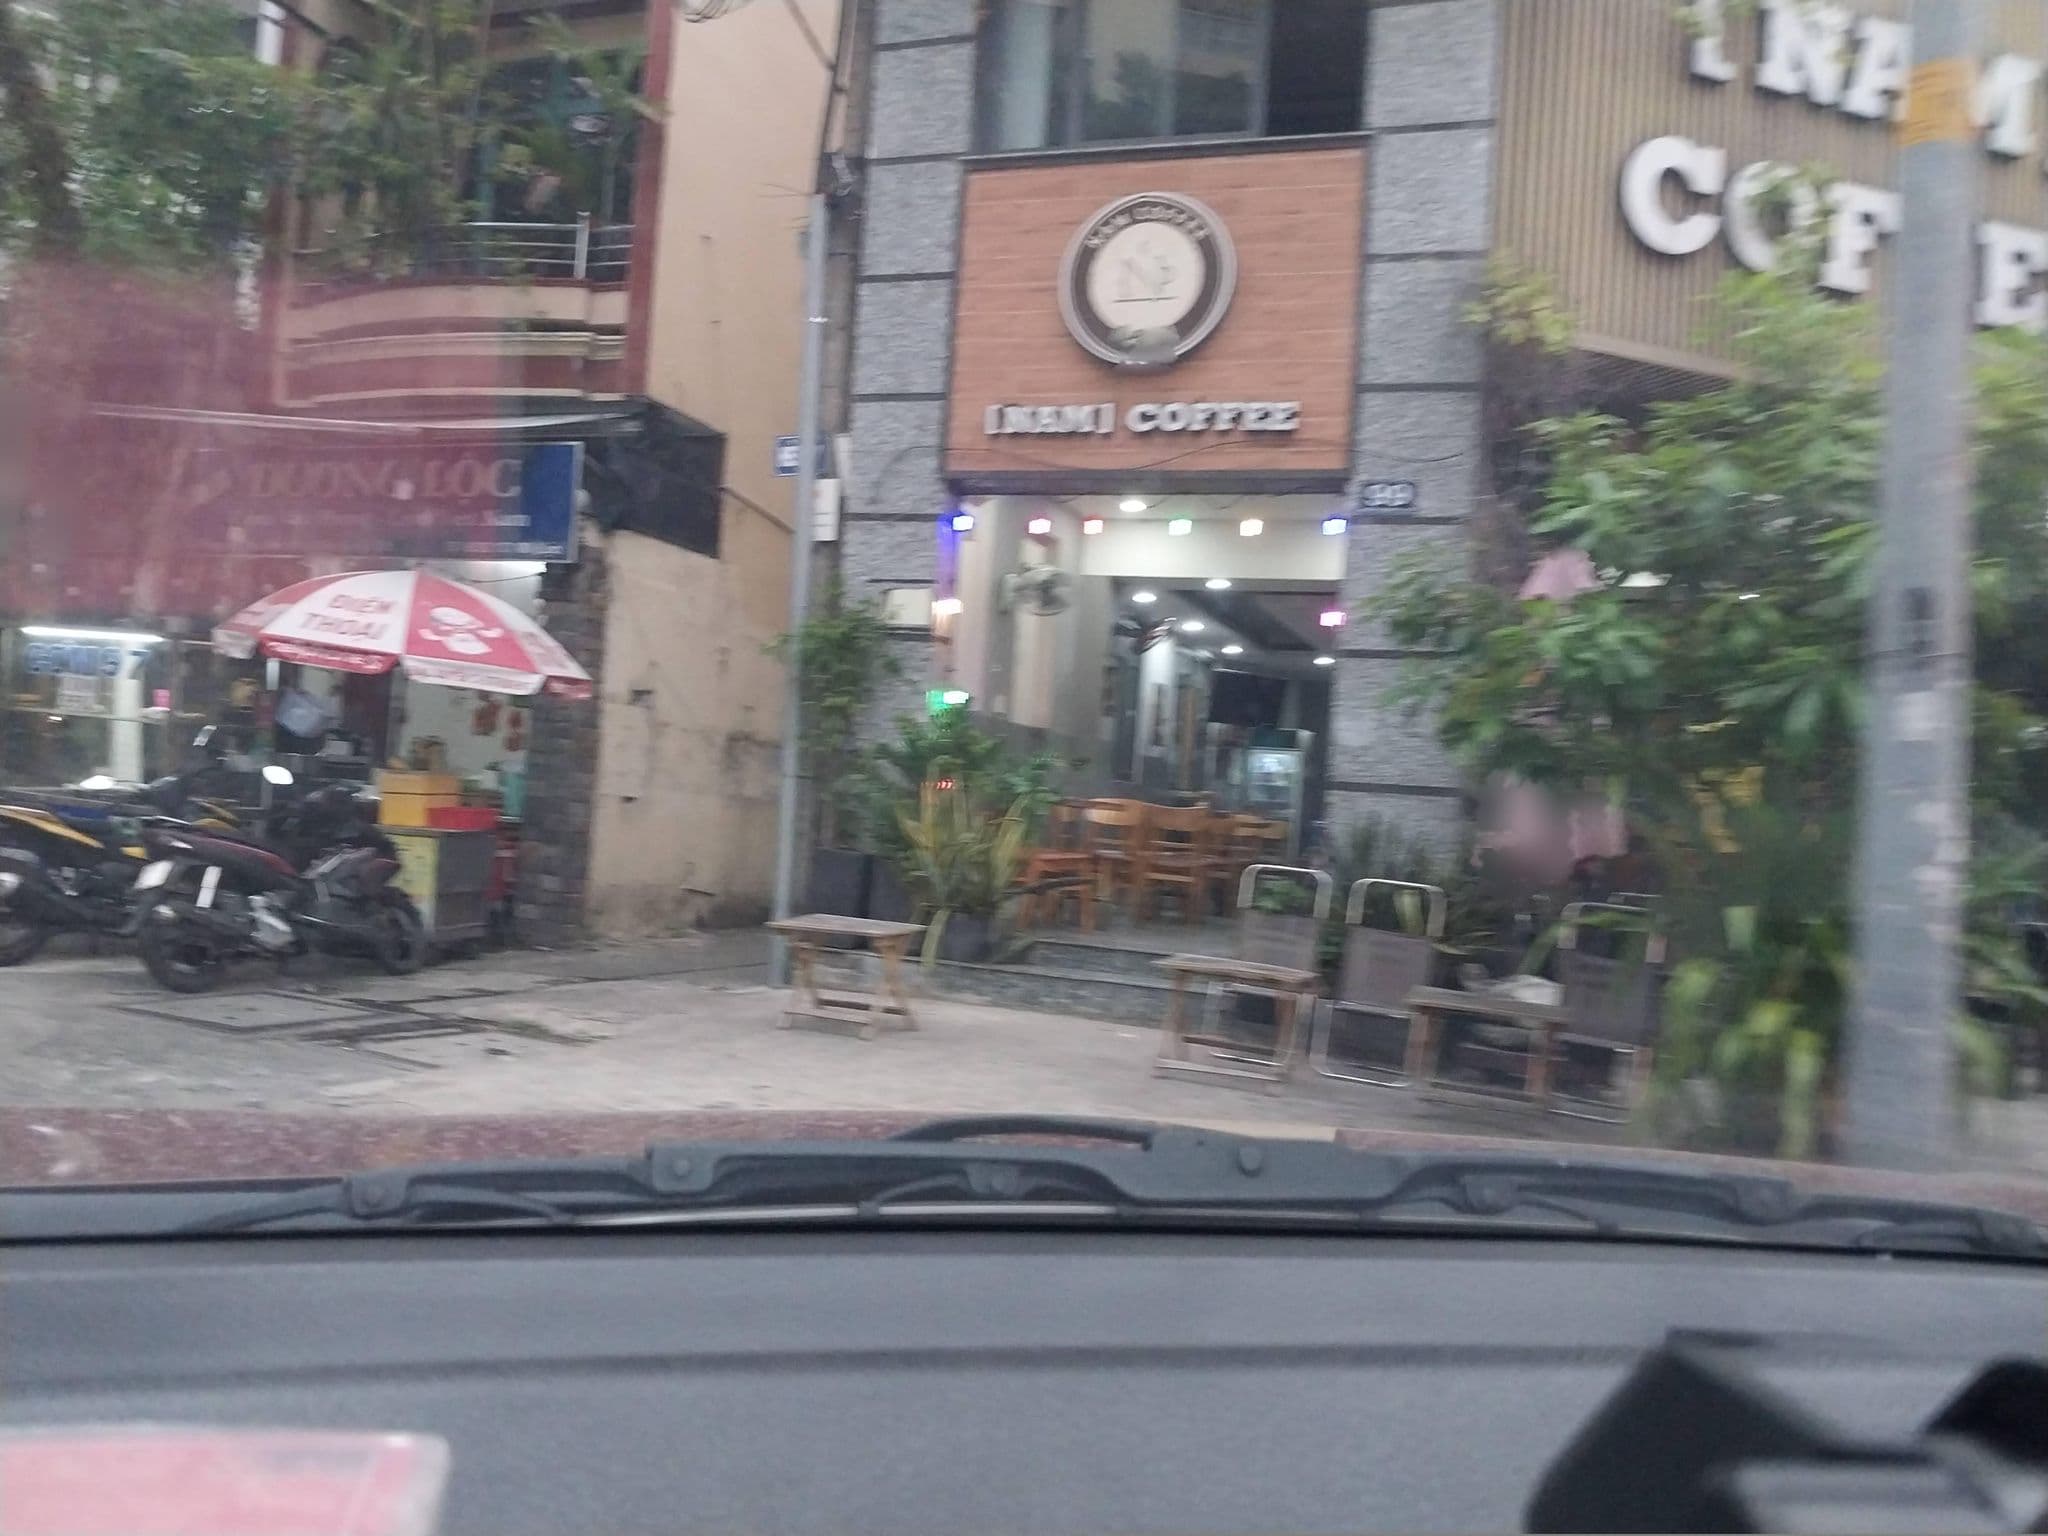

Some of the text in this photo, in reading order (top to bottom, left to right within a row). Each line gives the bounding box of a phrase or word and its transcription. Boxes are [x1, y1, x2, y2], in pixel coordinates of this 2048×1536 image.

[1620, 135, 2048, 328] COFE
[983, 400, 1301, 435] INAMI COFFEE
